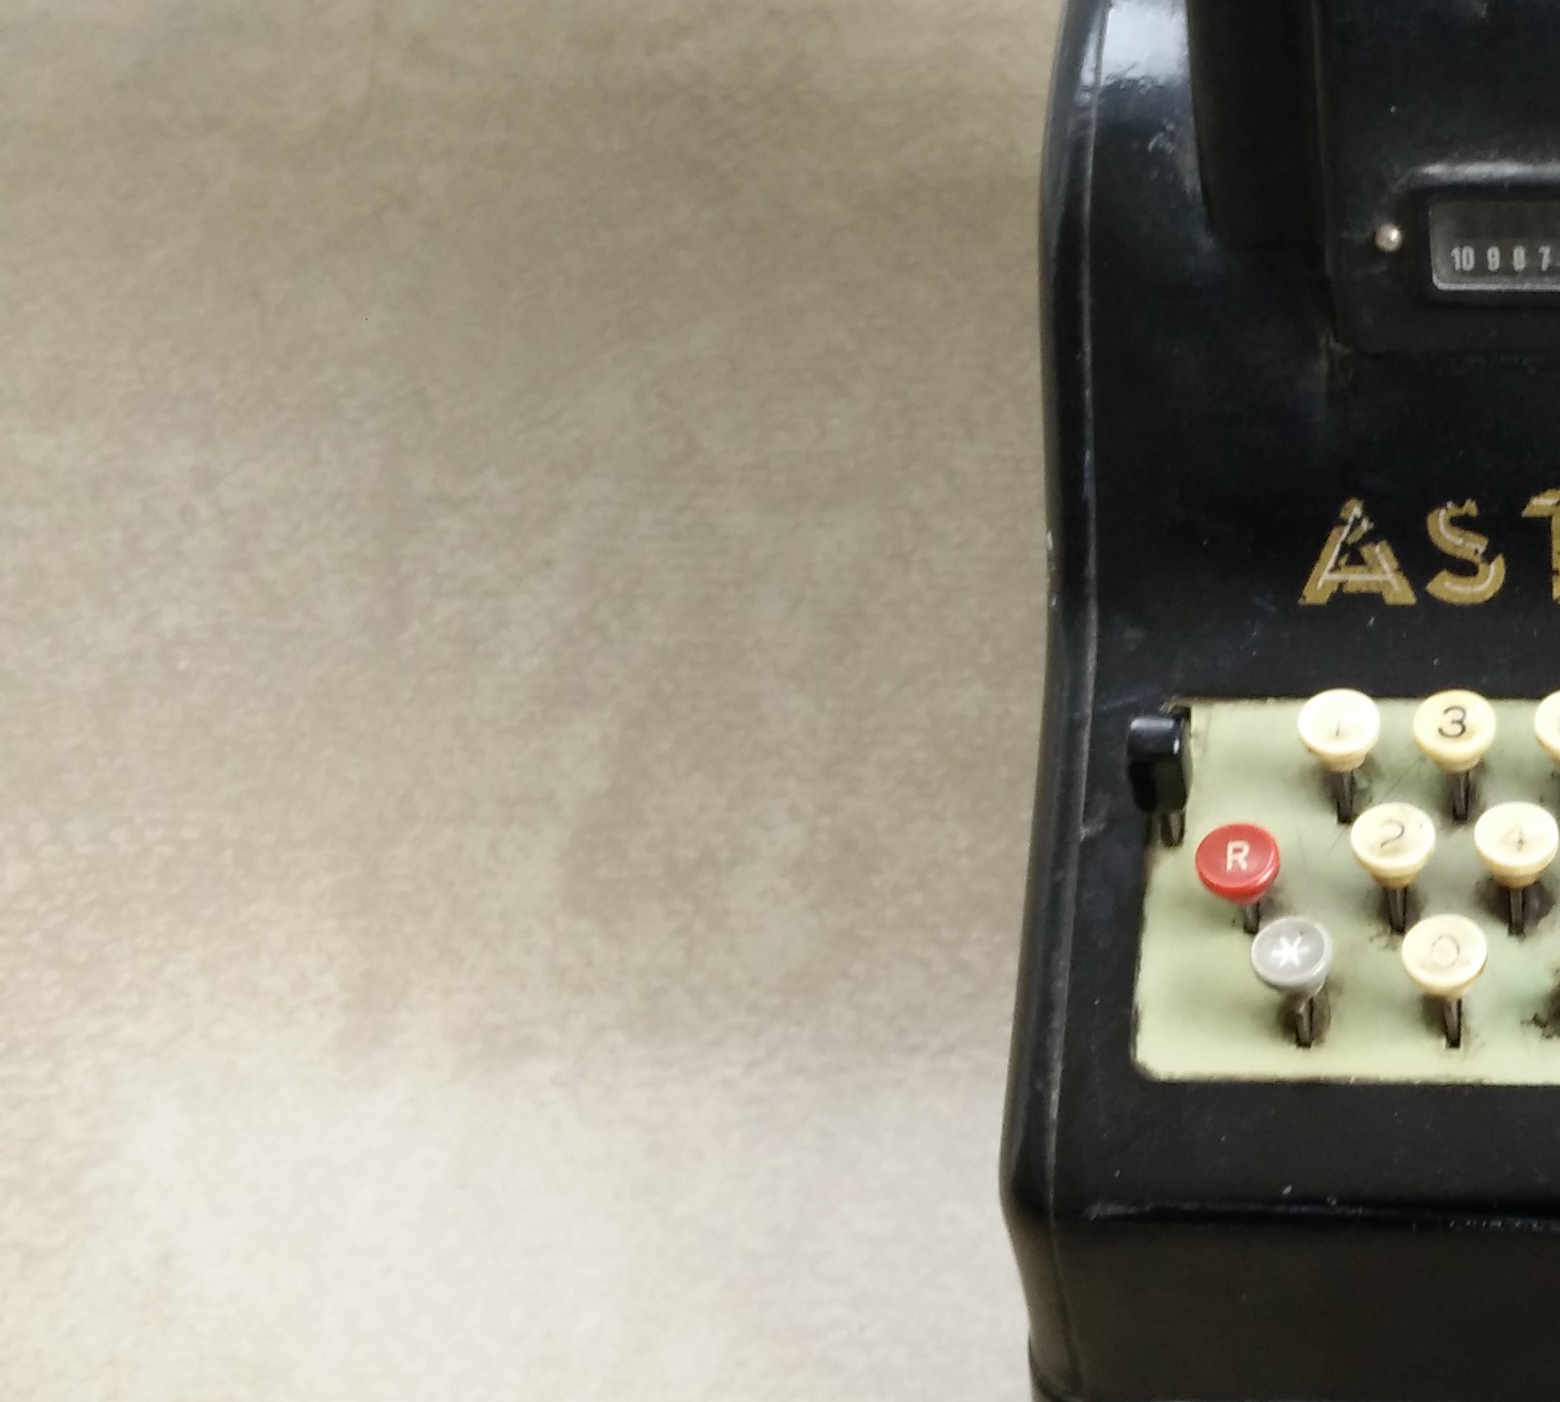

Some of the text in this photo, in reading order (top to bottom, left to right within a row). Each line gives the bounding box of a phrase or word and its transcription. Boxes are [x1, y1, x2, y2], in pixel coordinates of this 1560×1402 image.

[1437, 705, 1468, 739] 3
[1224, 839, 1250, 872] R
[1380, 818, 1408, 853] 2
